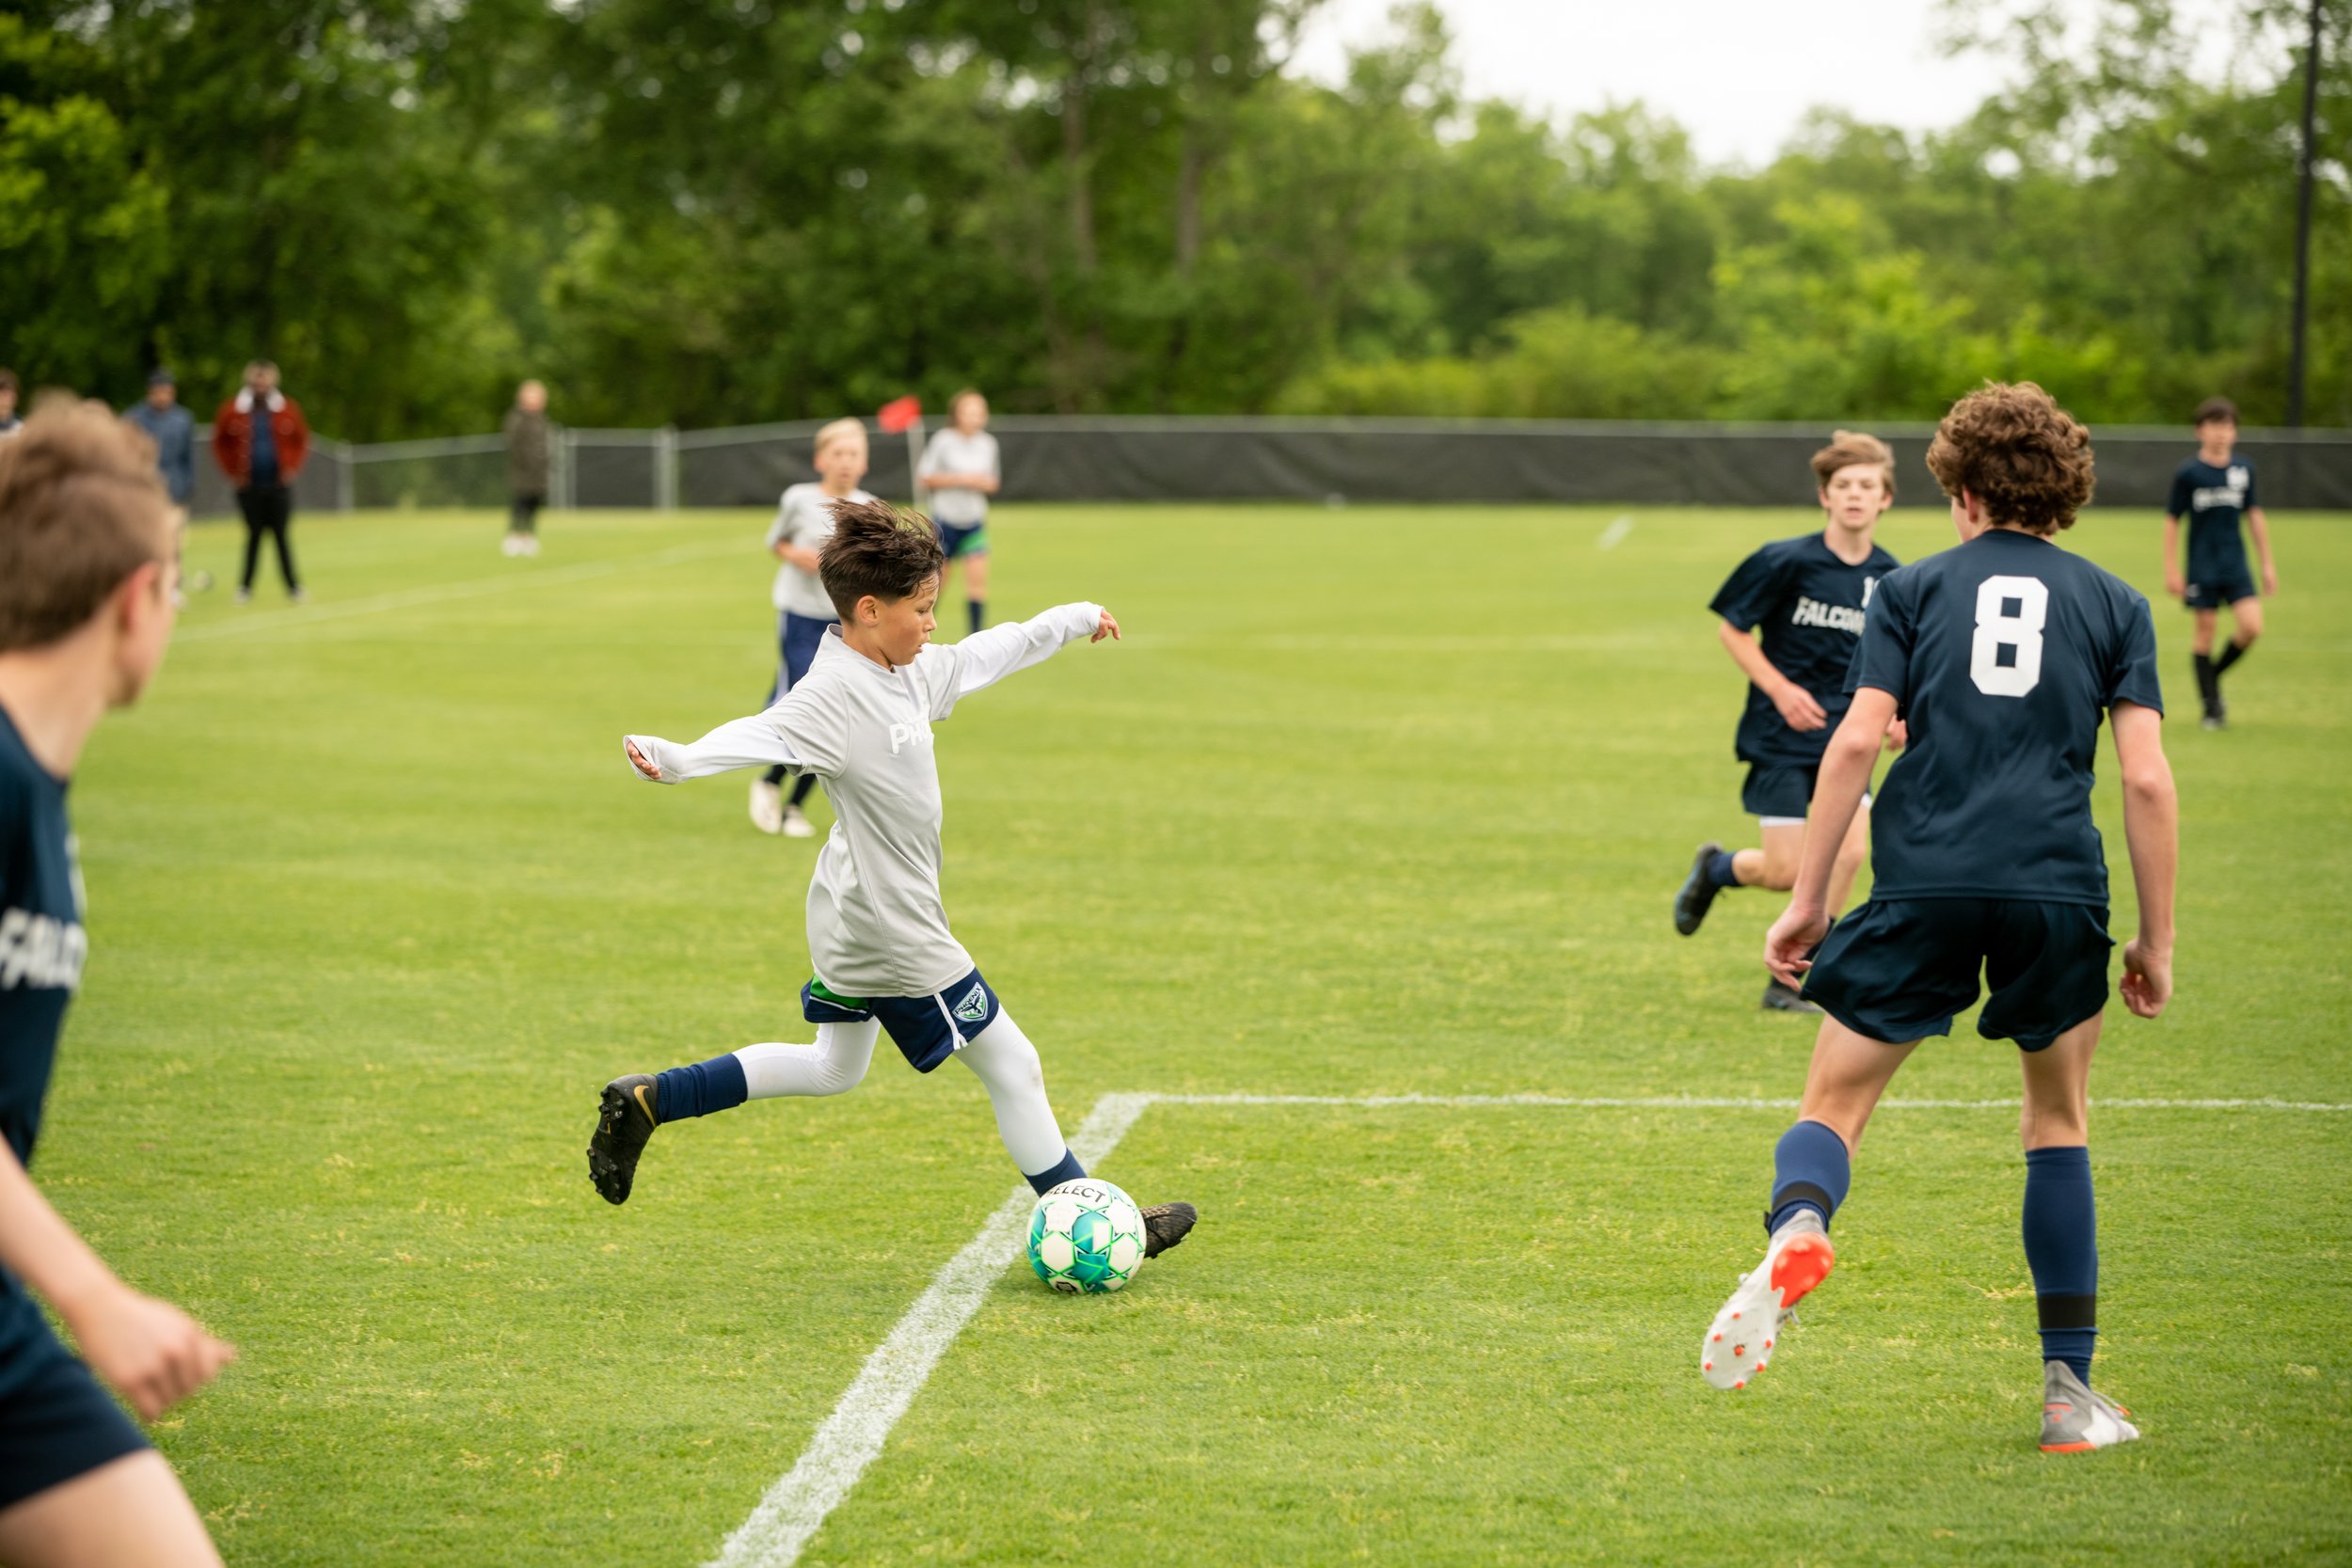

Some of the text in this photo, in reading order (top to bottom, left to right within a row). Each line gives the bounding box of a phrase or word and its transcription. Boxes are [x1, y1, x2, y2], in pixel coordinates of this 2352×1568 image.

[1862, 576, 1880, 609] 1
[1969, 575, 2049, 698] 8
[954, 987, 982, 1015] PHOENIX
